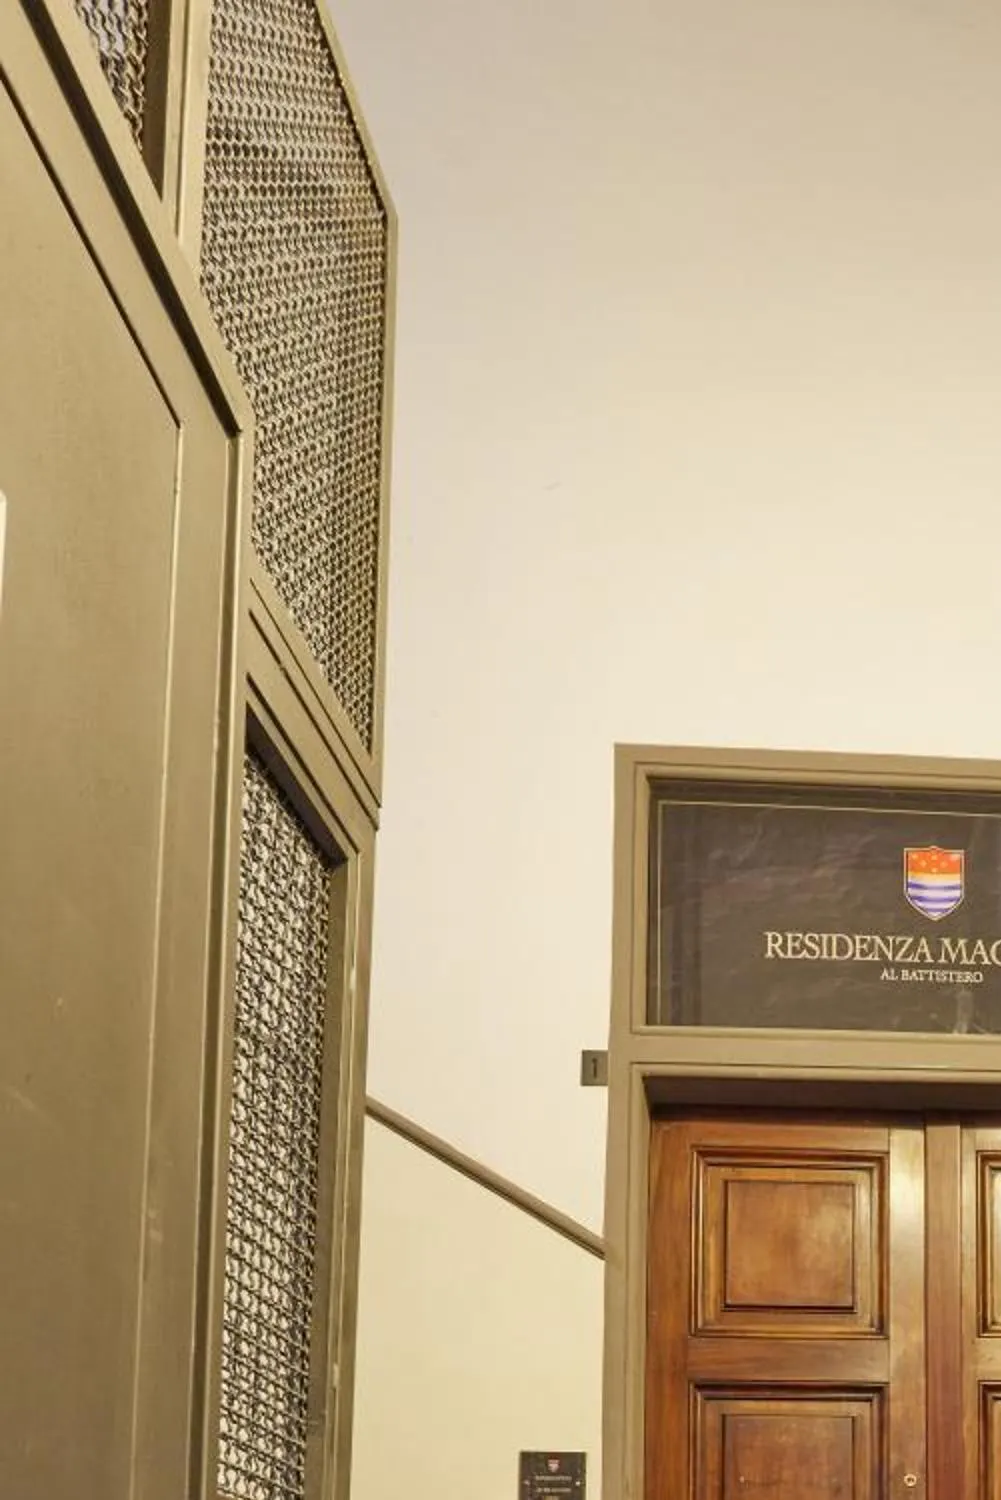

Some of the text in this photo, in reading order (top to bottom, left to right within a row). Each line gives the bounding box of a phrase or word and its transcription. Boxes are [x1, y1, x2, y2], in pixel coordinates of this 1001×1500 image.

[764, 931, 935, 964] RESIDENZA
[880, 967, 984, 983] AL BATTISTERO
